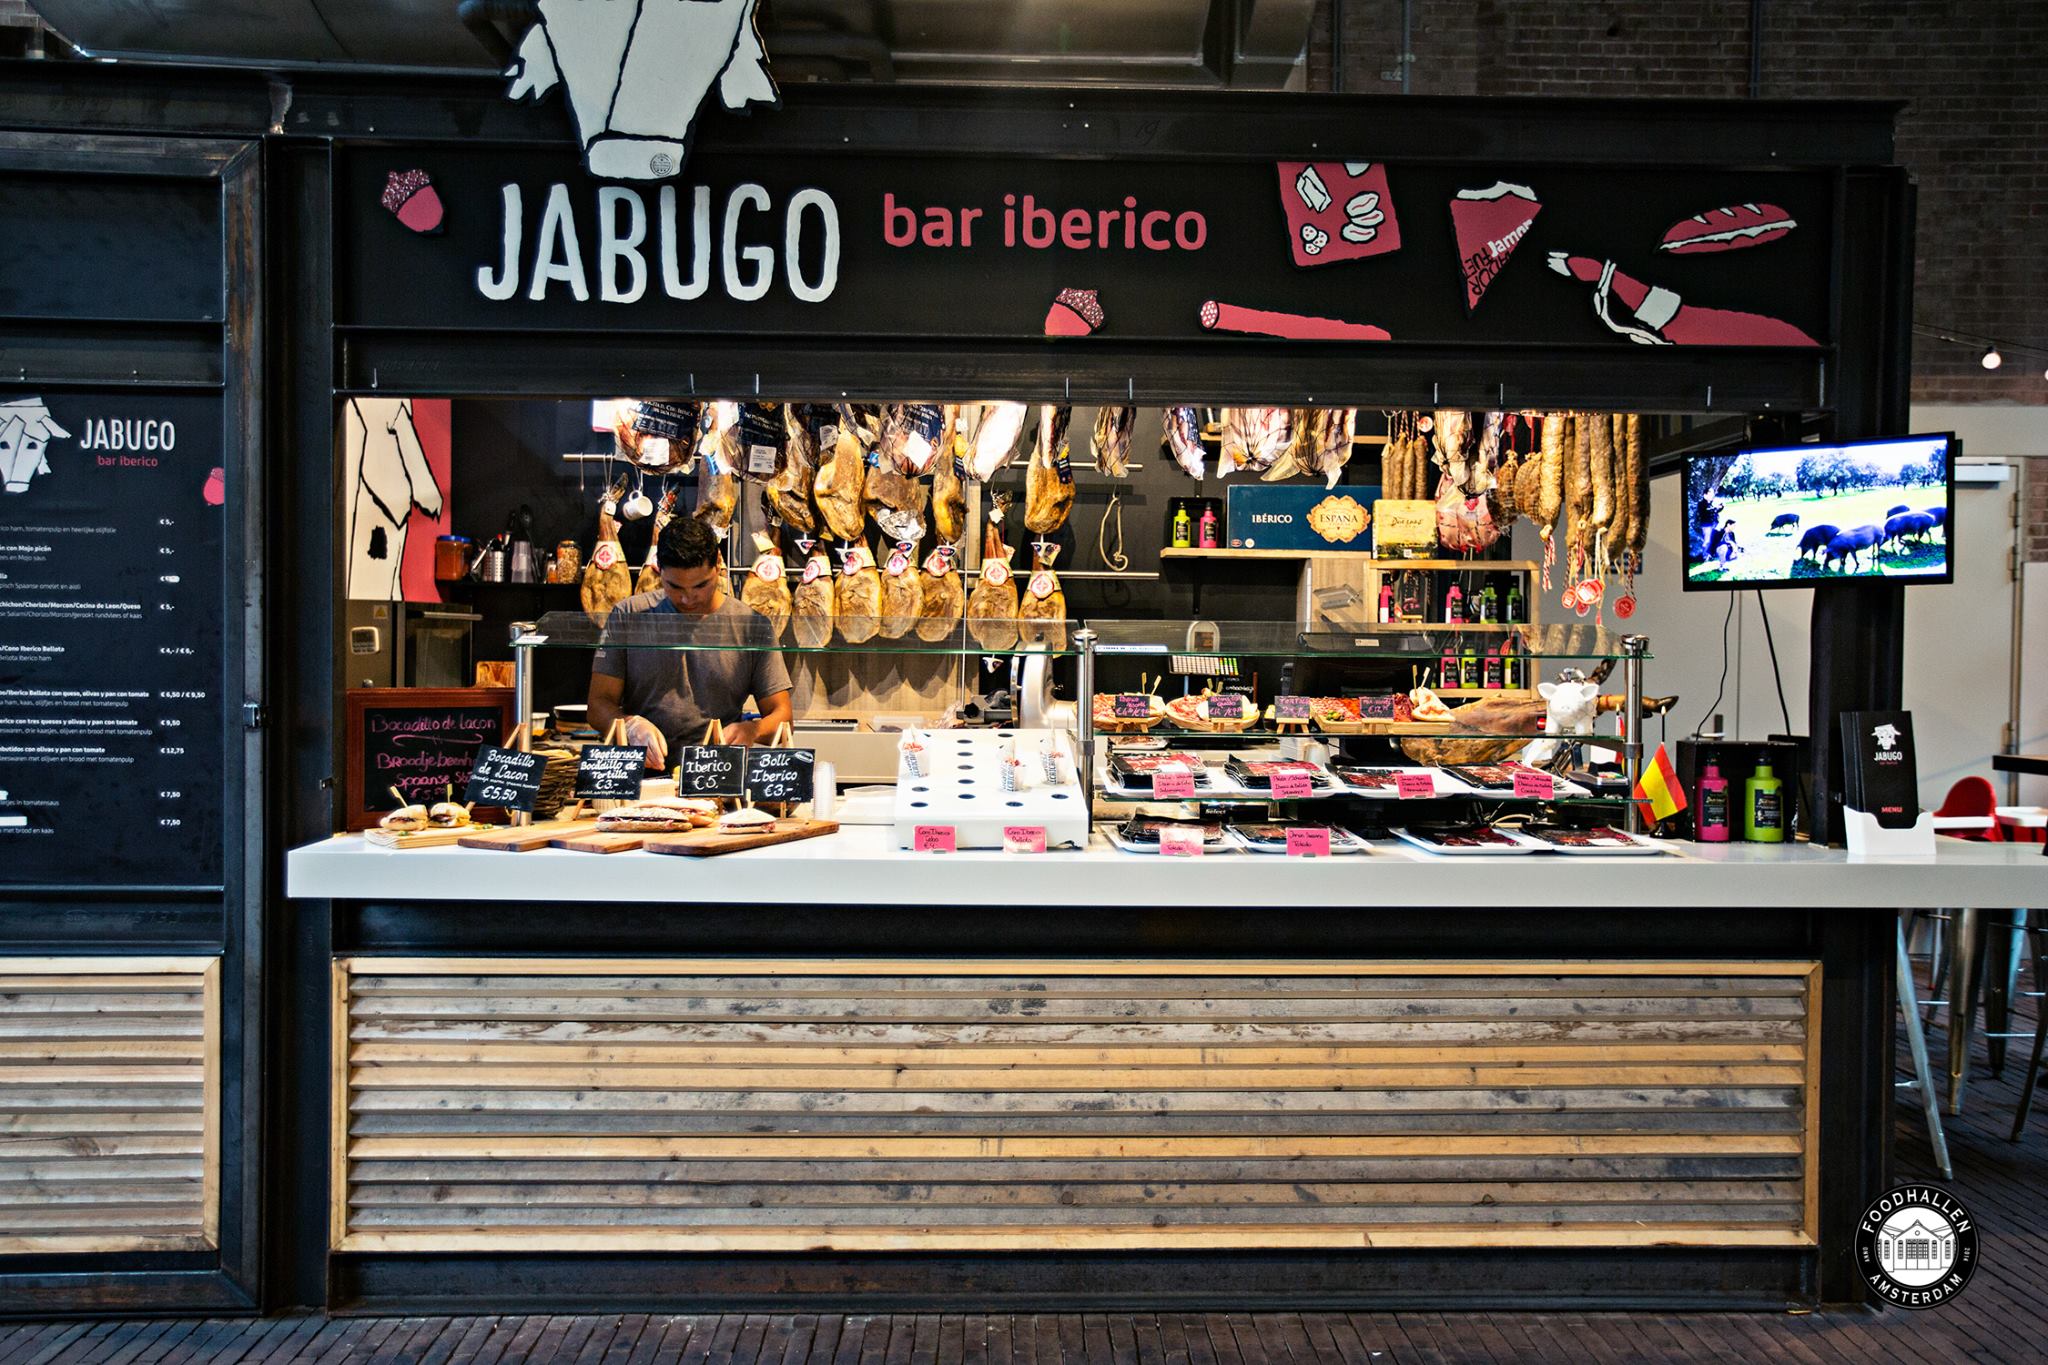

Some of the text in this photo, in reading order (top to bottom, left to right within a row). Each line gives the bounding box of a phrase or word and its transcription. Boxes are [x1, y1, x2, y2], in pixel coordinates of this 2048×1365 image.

[884, 193, 1207, 251] bar iberico
[478, 183, 841, 304] JABUGO
[80, 419, 176, 451] JABUGO
[97, 455, 158, 468] bar iberico
[1252, 513, 1293, 524] IBÉRICO
[166, 691, 180, 699] 6,50
[191, 691, 206, 699] 9,50
[116, 728, 153, 737] tomatenpulp
[488, 750, 536, 768] Bocadillo
[590, 748, 643, 760] Vegetarische
[695, 747, 718, 760] Pan
[1874, 751, 1903, 761] JABUGO
[98, 756, 135, 764] tomatenpulp
[581, 760, 638, 770] Bocadillo de
[478, 761, 528, 781] de Lacon
[686, 761, 732, 773] Iberico
[751, 769, 798, 783] Iberico
[166, 791, 181, 799] 7,50
[482, 785, 517, 801] €5,50
[166, 819, 181, 827] 7,50
